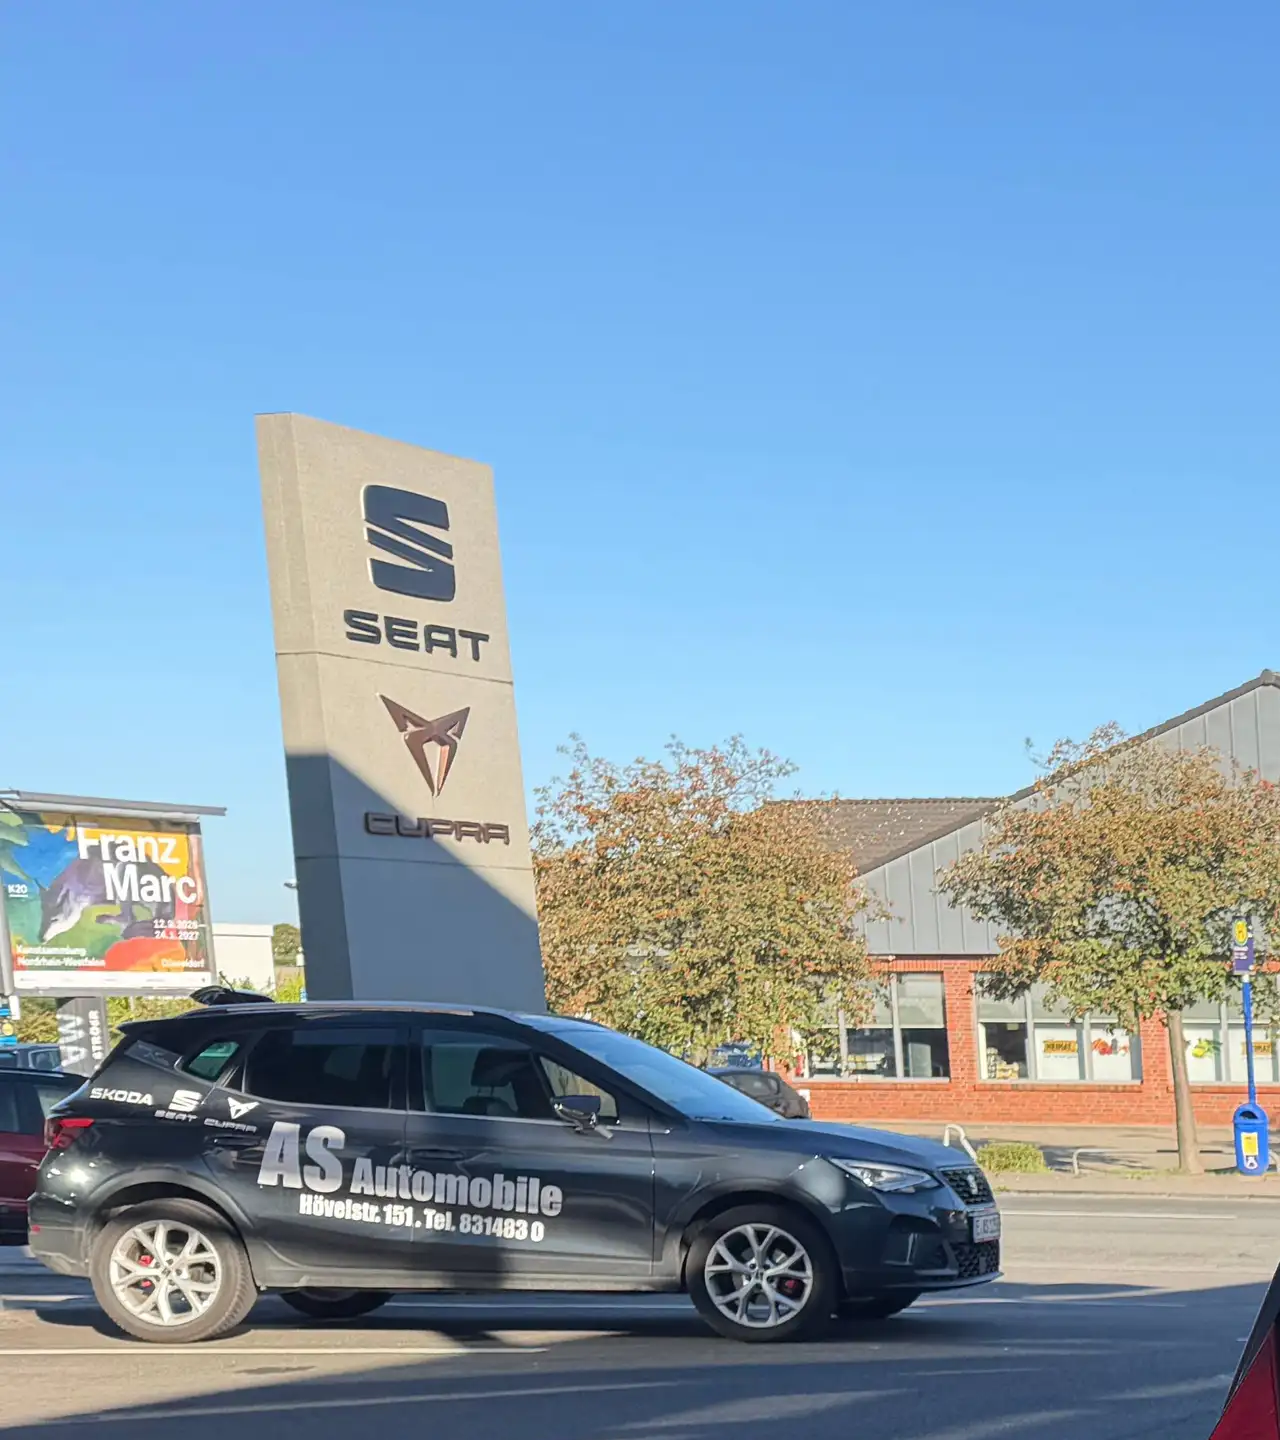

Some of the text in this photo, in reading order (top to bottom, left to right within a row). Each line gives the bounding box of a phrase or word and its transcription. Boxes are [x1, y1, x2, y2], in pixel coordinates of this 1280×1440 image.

[343, 609, 490, 662] SEAT
[76, 823, 180, 864] Franz
[364, 812, 511, 845] CUPRA
[8, 884, 28, 894] K20
[103, 862, 197, 904] Marc
[154, 1110, 199, 1123] SEAT
[203, 1117, 257, 1134] CUPRA
[257, 1121, 564, 1217] AS Automobile
[299, 1194, 380, 1223] Hövelstr.
[424, 1208, 455, 1232] Tel.
